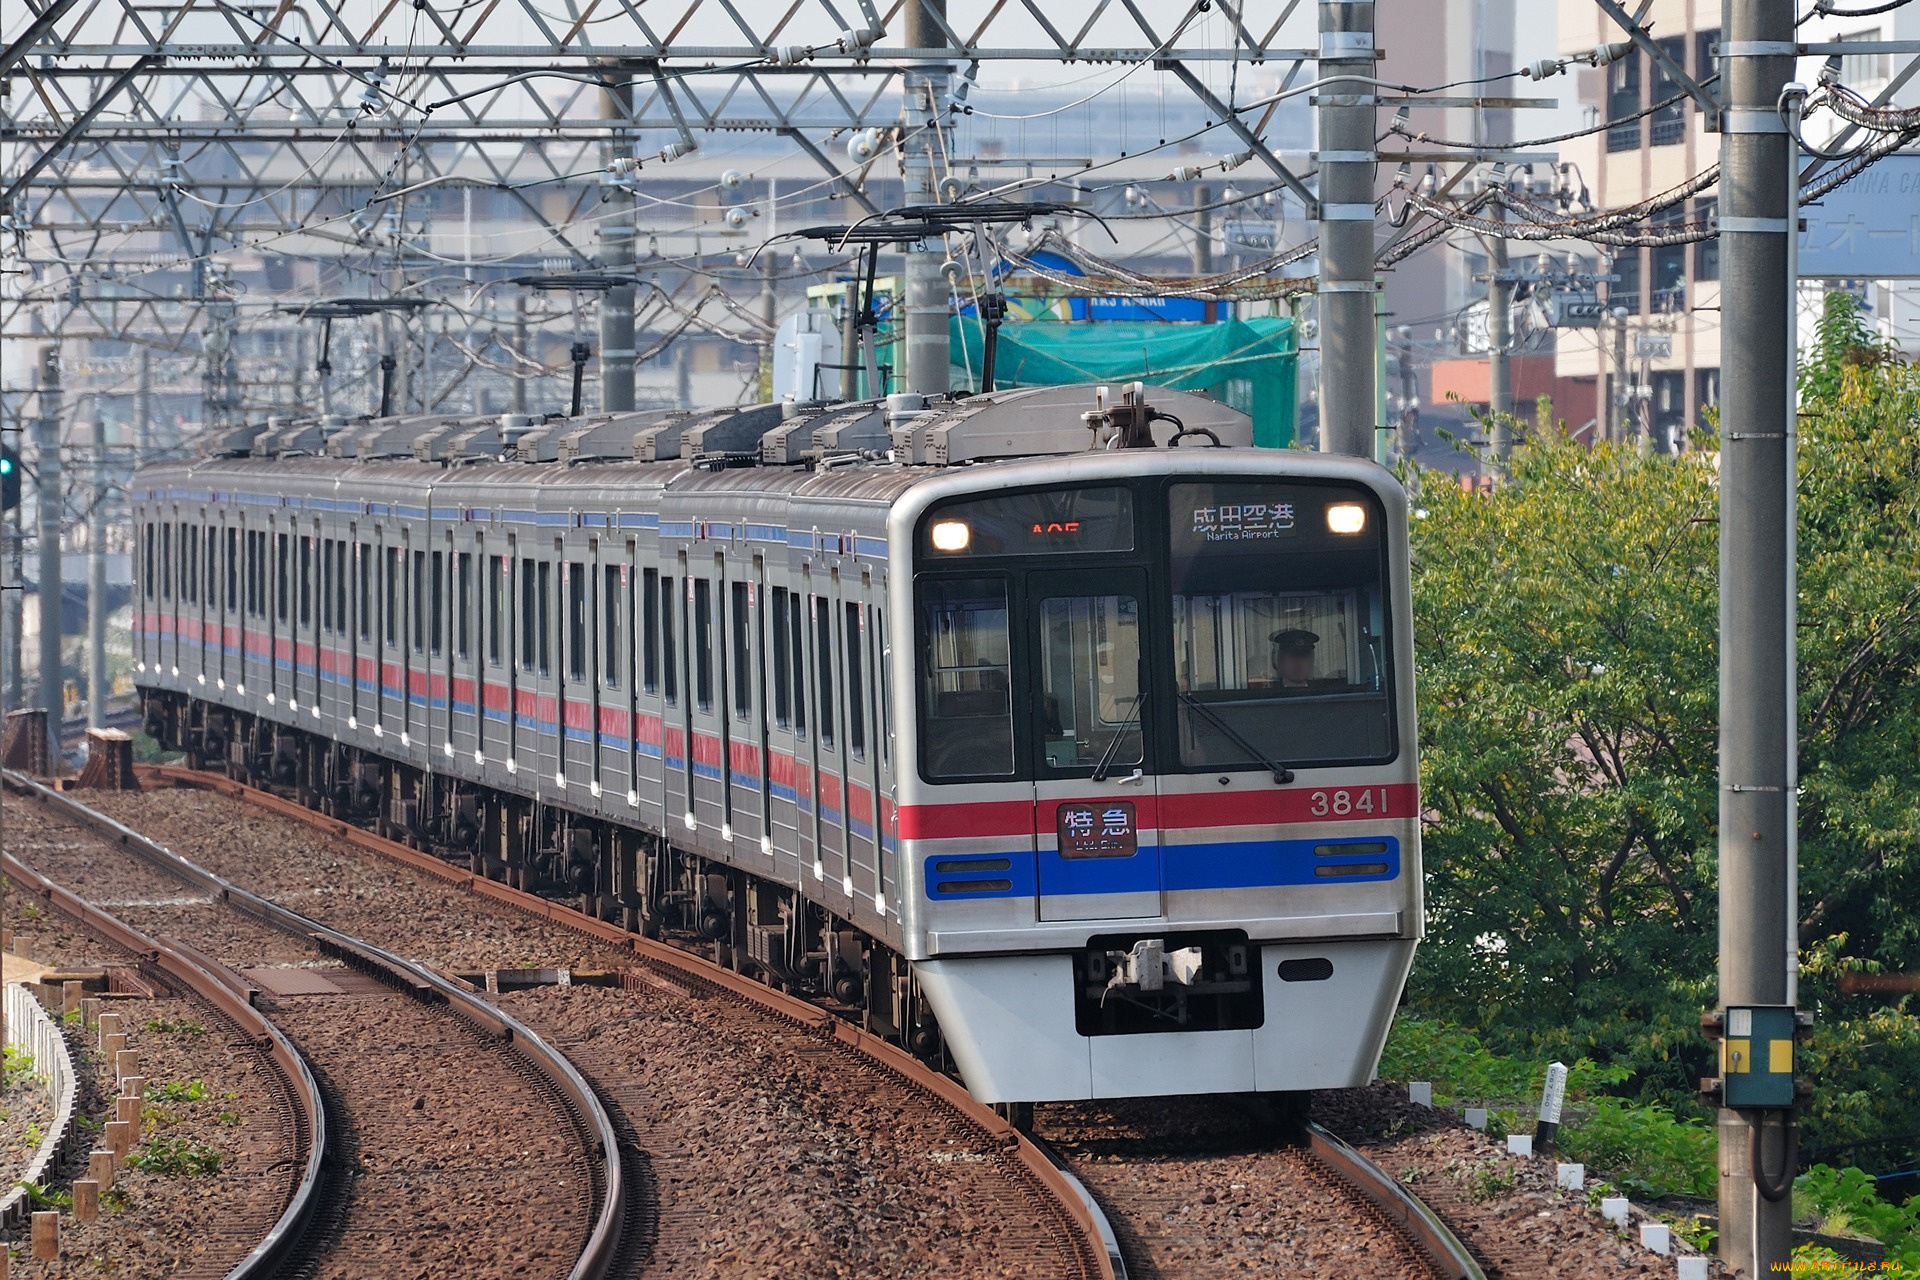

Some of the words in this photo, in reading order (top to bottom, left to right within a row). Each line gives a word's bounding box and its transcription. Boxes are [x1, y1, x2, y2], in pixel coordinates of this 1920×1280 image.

[1192, 503, 1294, 532] 成田空港
[1207, 531, 1239, 541] Narita
[1242, 529, 1280, 541] Airport
[1311, 788, 1388, 816] 3841
[1064, 808, 1130, 838] 特急
